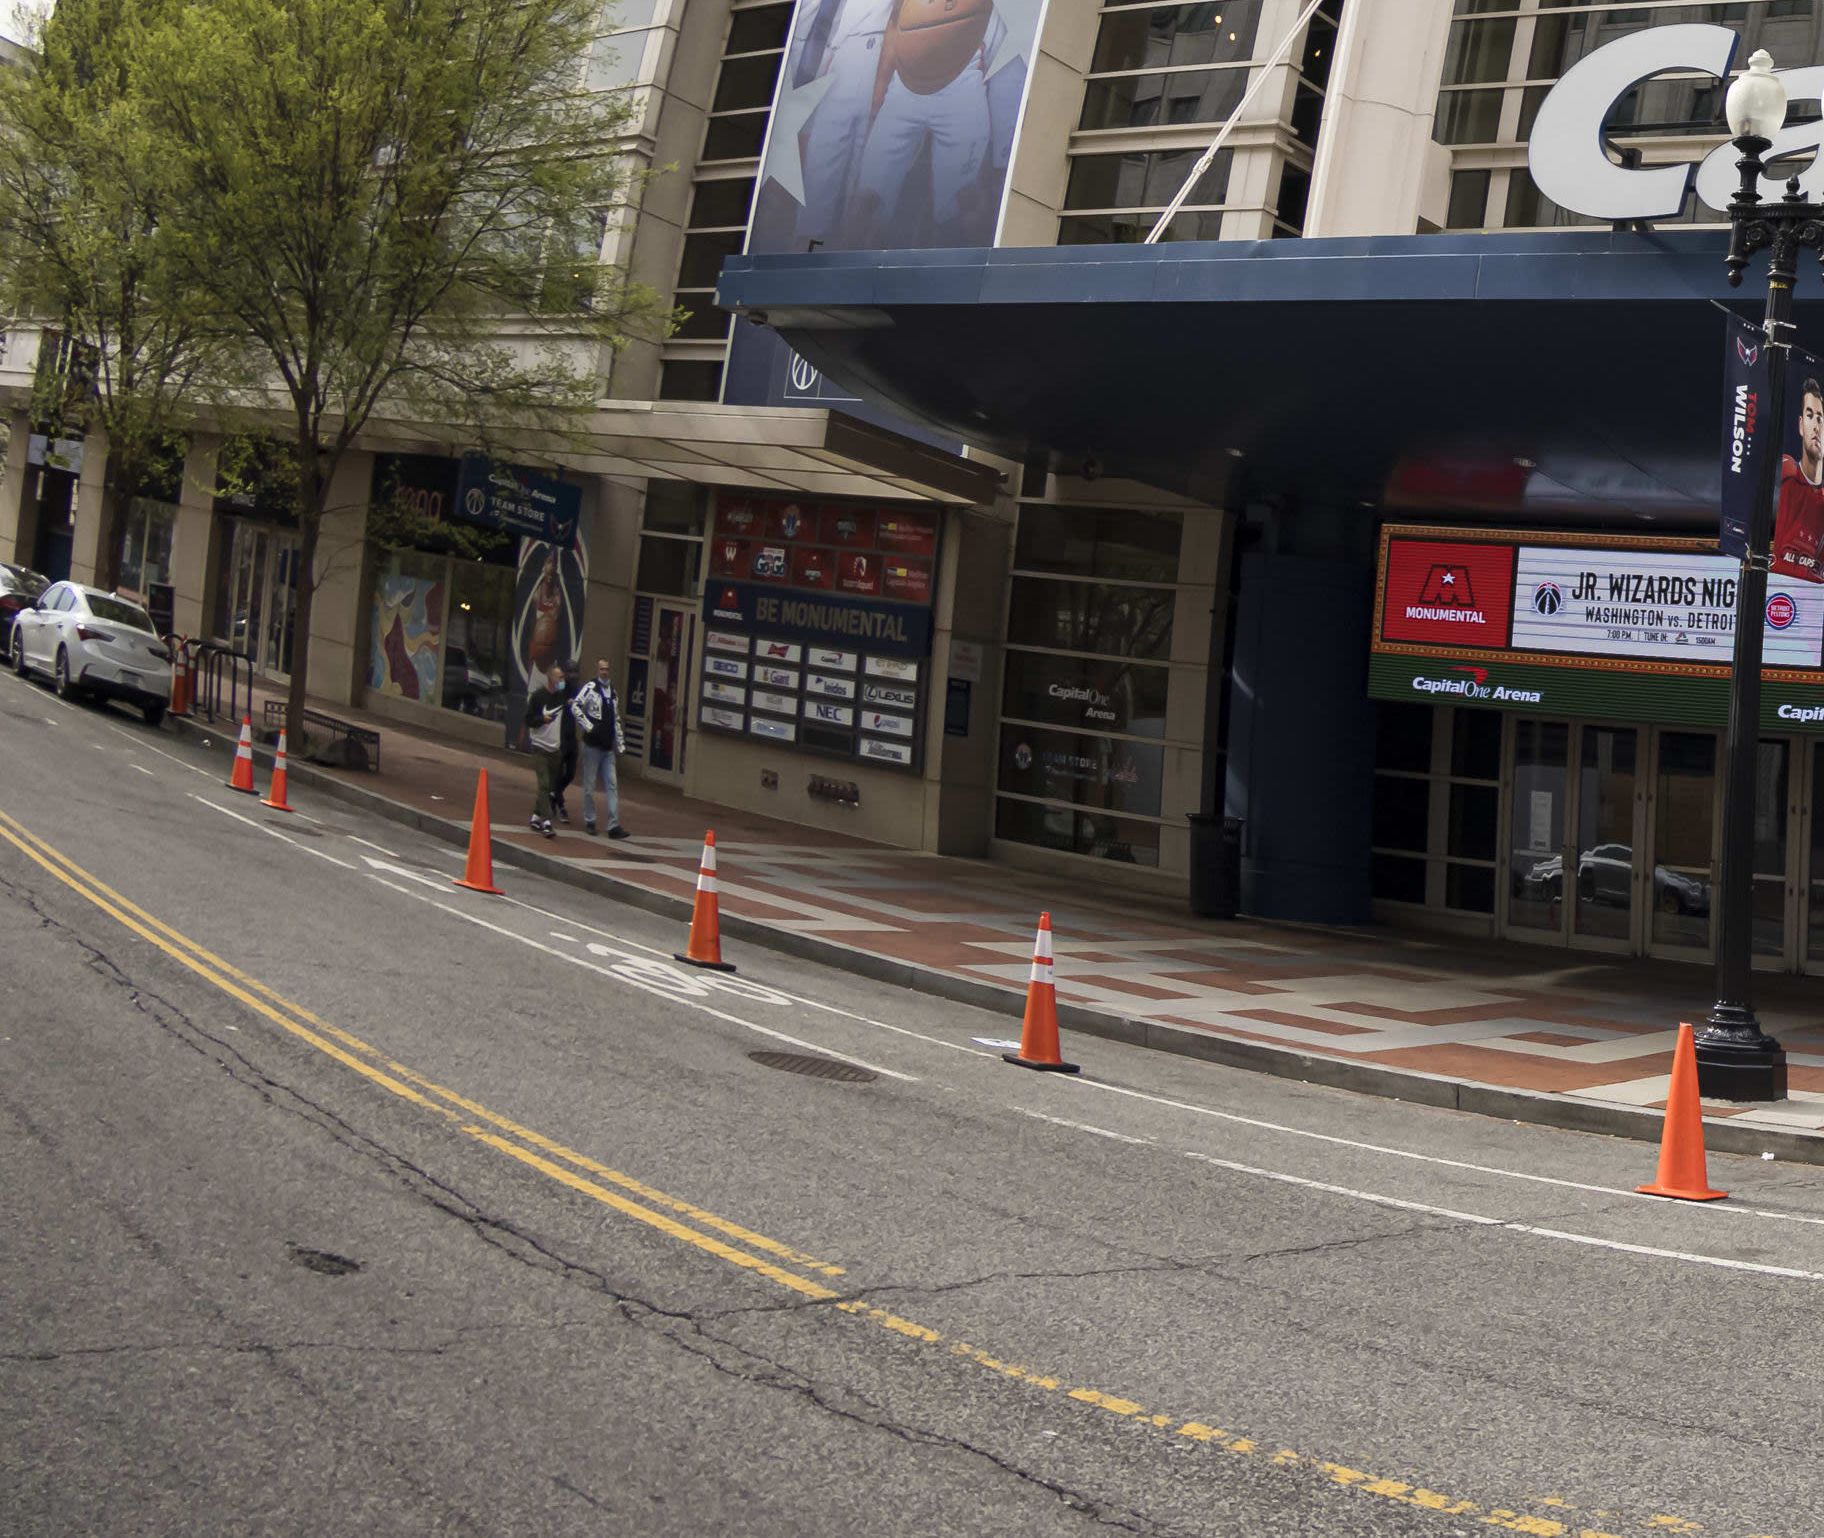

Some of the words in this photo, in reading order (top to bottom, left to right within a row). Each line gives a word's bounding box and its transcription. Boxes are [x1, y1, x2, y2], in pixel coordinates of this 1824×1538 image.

[1747, 392, 1758, 434] TOM
[1731, 384, 1749, 474] WILSON
[1783, 552, 1796, 563] ALL
[1798, 556, 1816, 568] CAPS
[1572, 571, 1601, 602] JR.
[1608, 572, 1697, 607] WIZARDS
[1701, 576, 1737, 608] NIG
[756, 597, 777, 624] BE
[781, 599, 908, 642] MONUMENTAL
[1406, 606, 1486, 625] MONUMENTAL
[1585, 605, 1663, 627] WASHINGTON
[1687, 612, 1737, 630] DETROI
[877, 689, 914, 705] LEXUS
[1492, 685, 1541, 703] Arena
[816, 704, 842, 722] NEC
[1085, 706, 1116, 721] Arena
